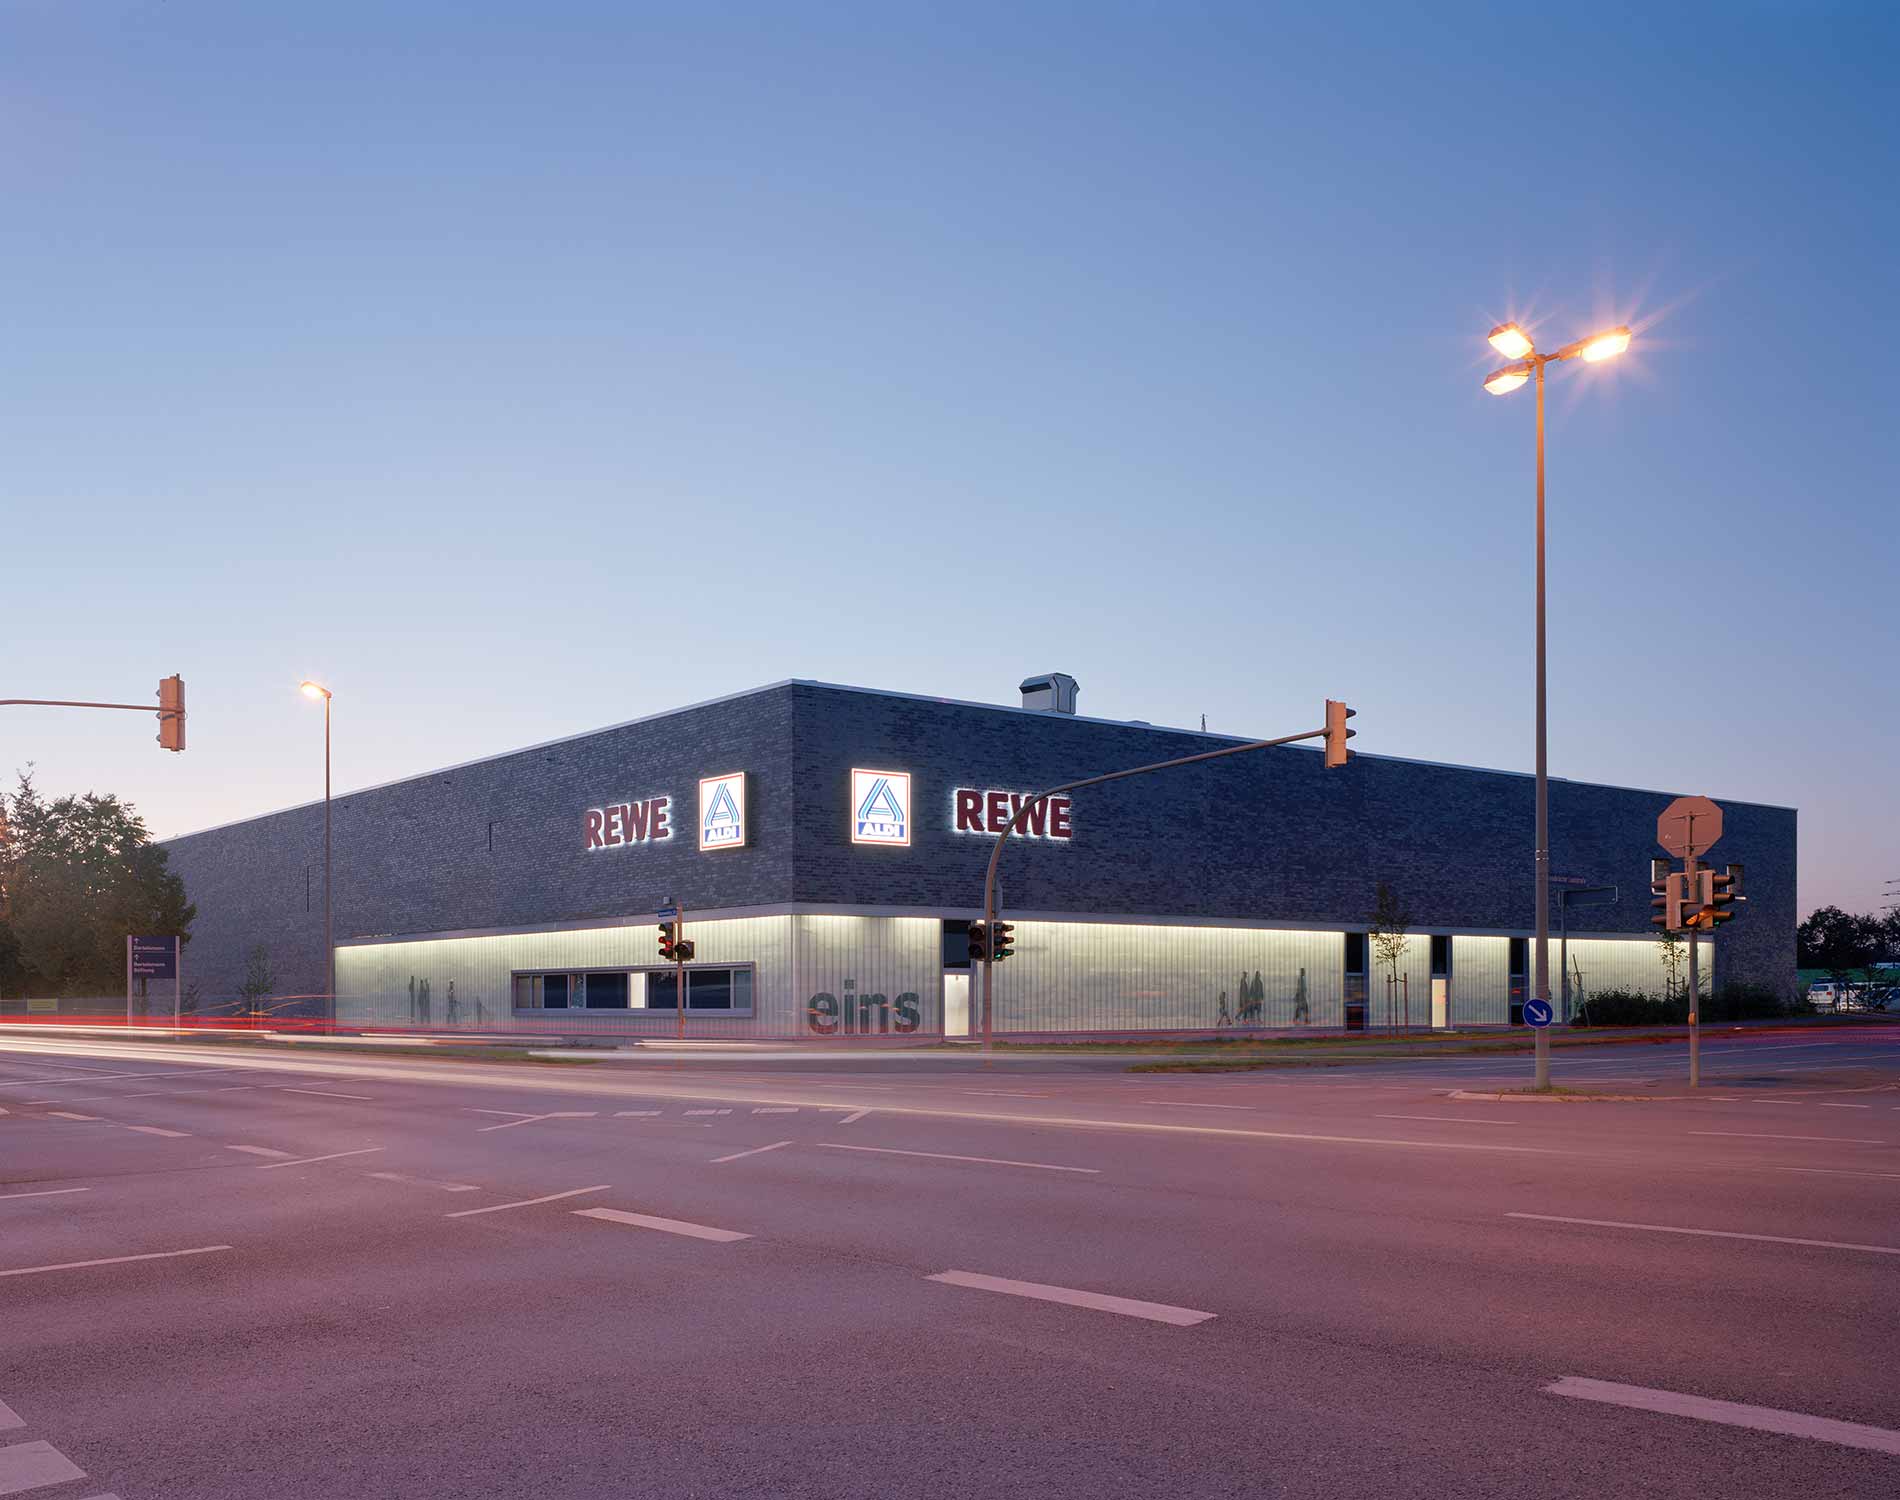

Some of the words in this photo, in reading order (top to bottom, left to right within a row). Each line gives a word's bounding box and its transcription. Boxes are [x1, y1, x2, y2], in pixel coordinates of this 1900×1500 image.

[584, 797, 669, 848] REWE
[707, 826, 737, 842] ALDI
[860, 822, 901, 837] ALDI
[957, 789, 1073, 838] REWE
[807, 979, 921, 1034] eins
